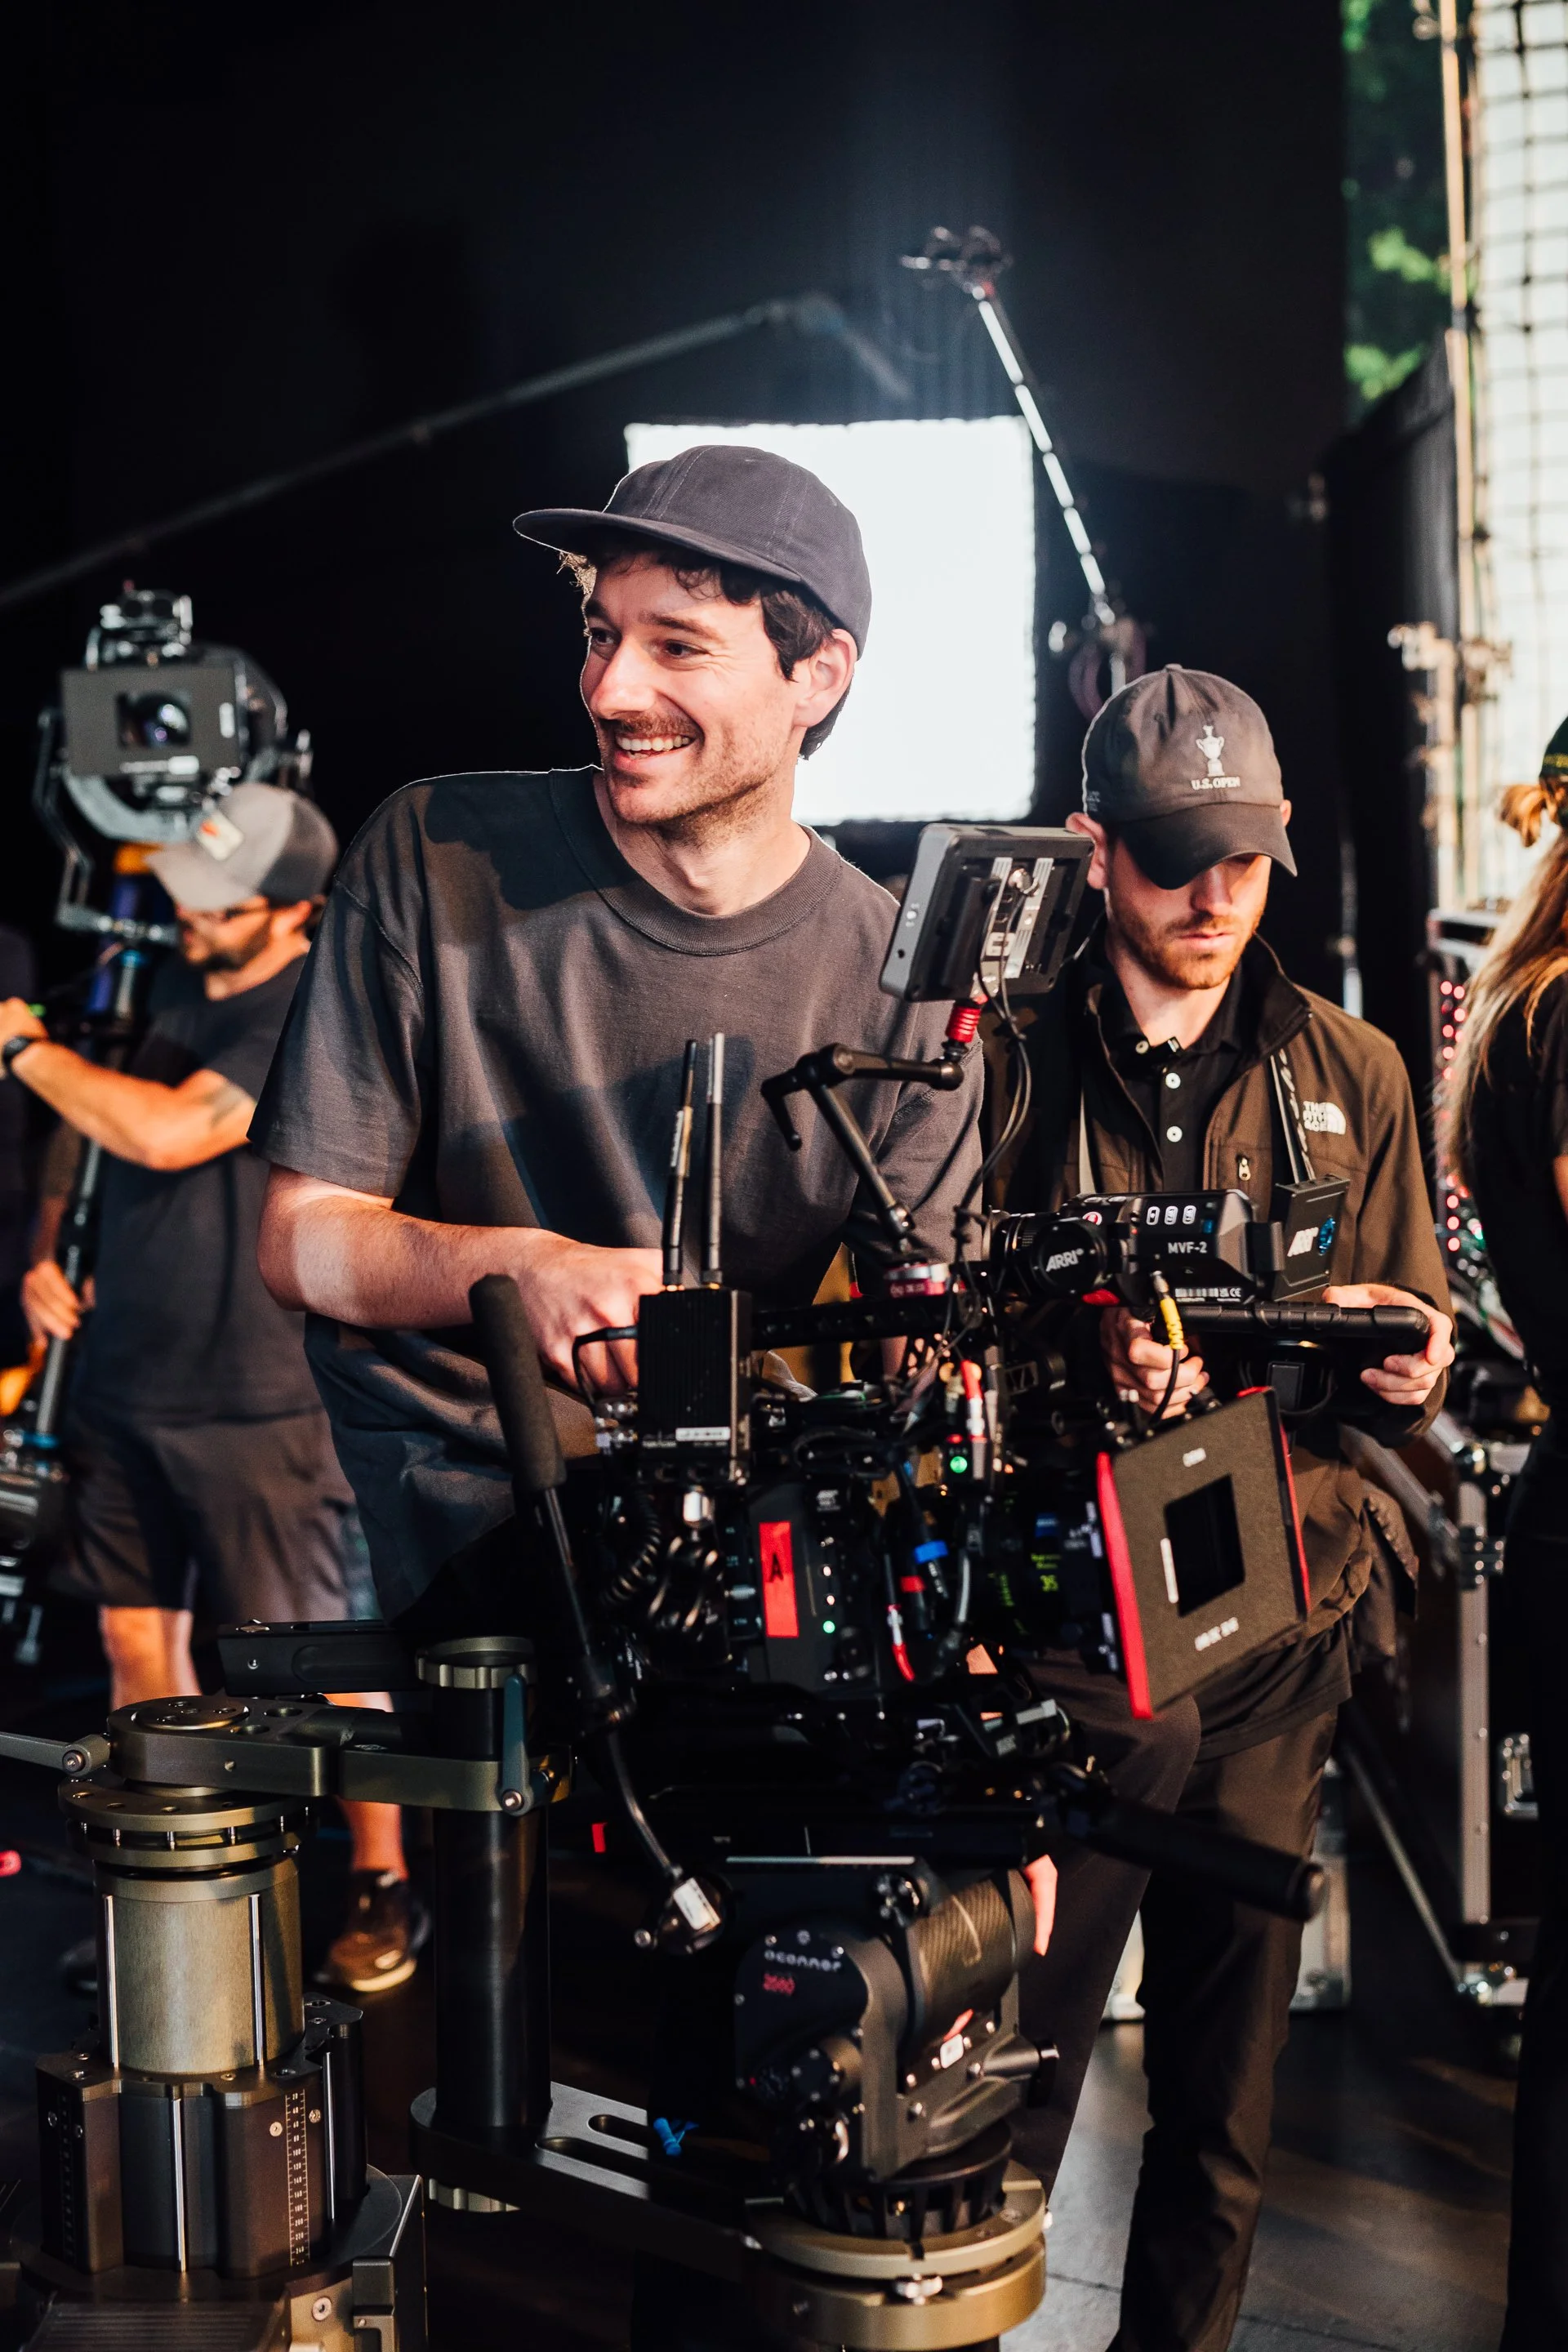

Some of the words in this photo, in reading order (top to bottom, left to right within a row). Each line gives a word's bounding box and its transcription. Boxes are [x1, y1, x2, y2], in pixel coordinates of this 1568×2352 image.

[1191, 777, 1214, 791] U.S.
[1213, 776, 1241, 789] OPEN
[1168, 1241, 1208, 1254] MVF-2
[1045, 1249, 1083, 1272] ARRI
[768, 1552, 784, 1582] A
